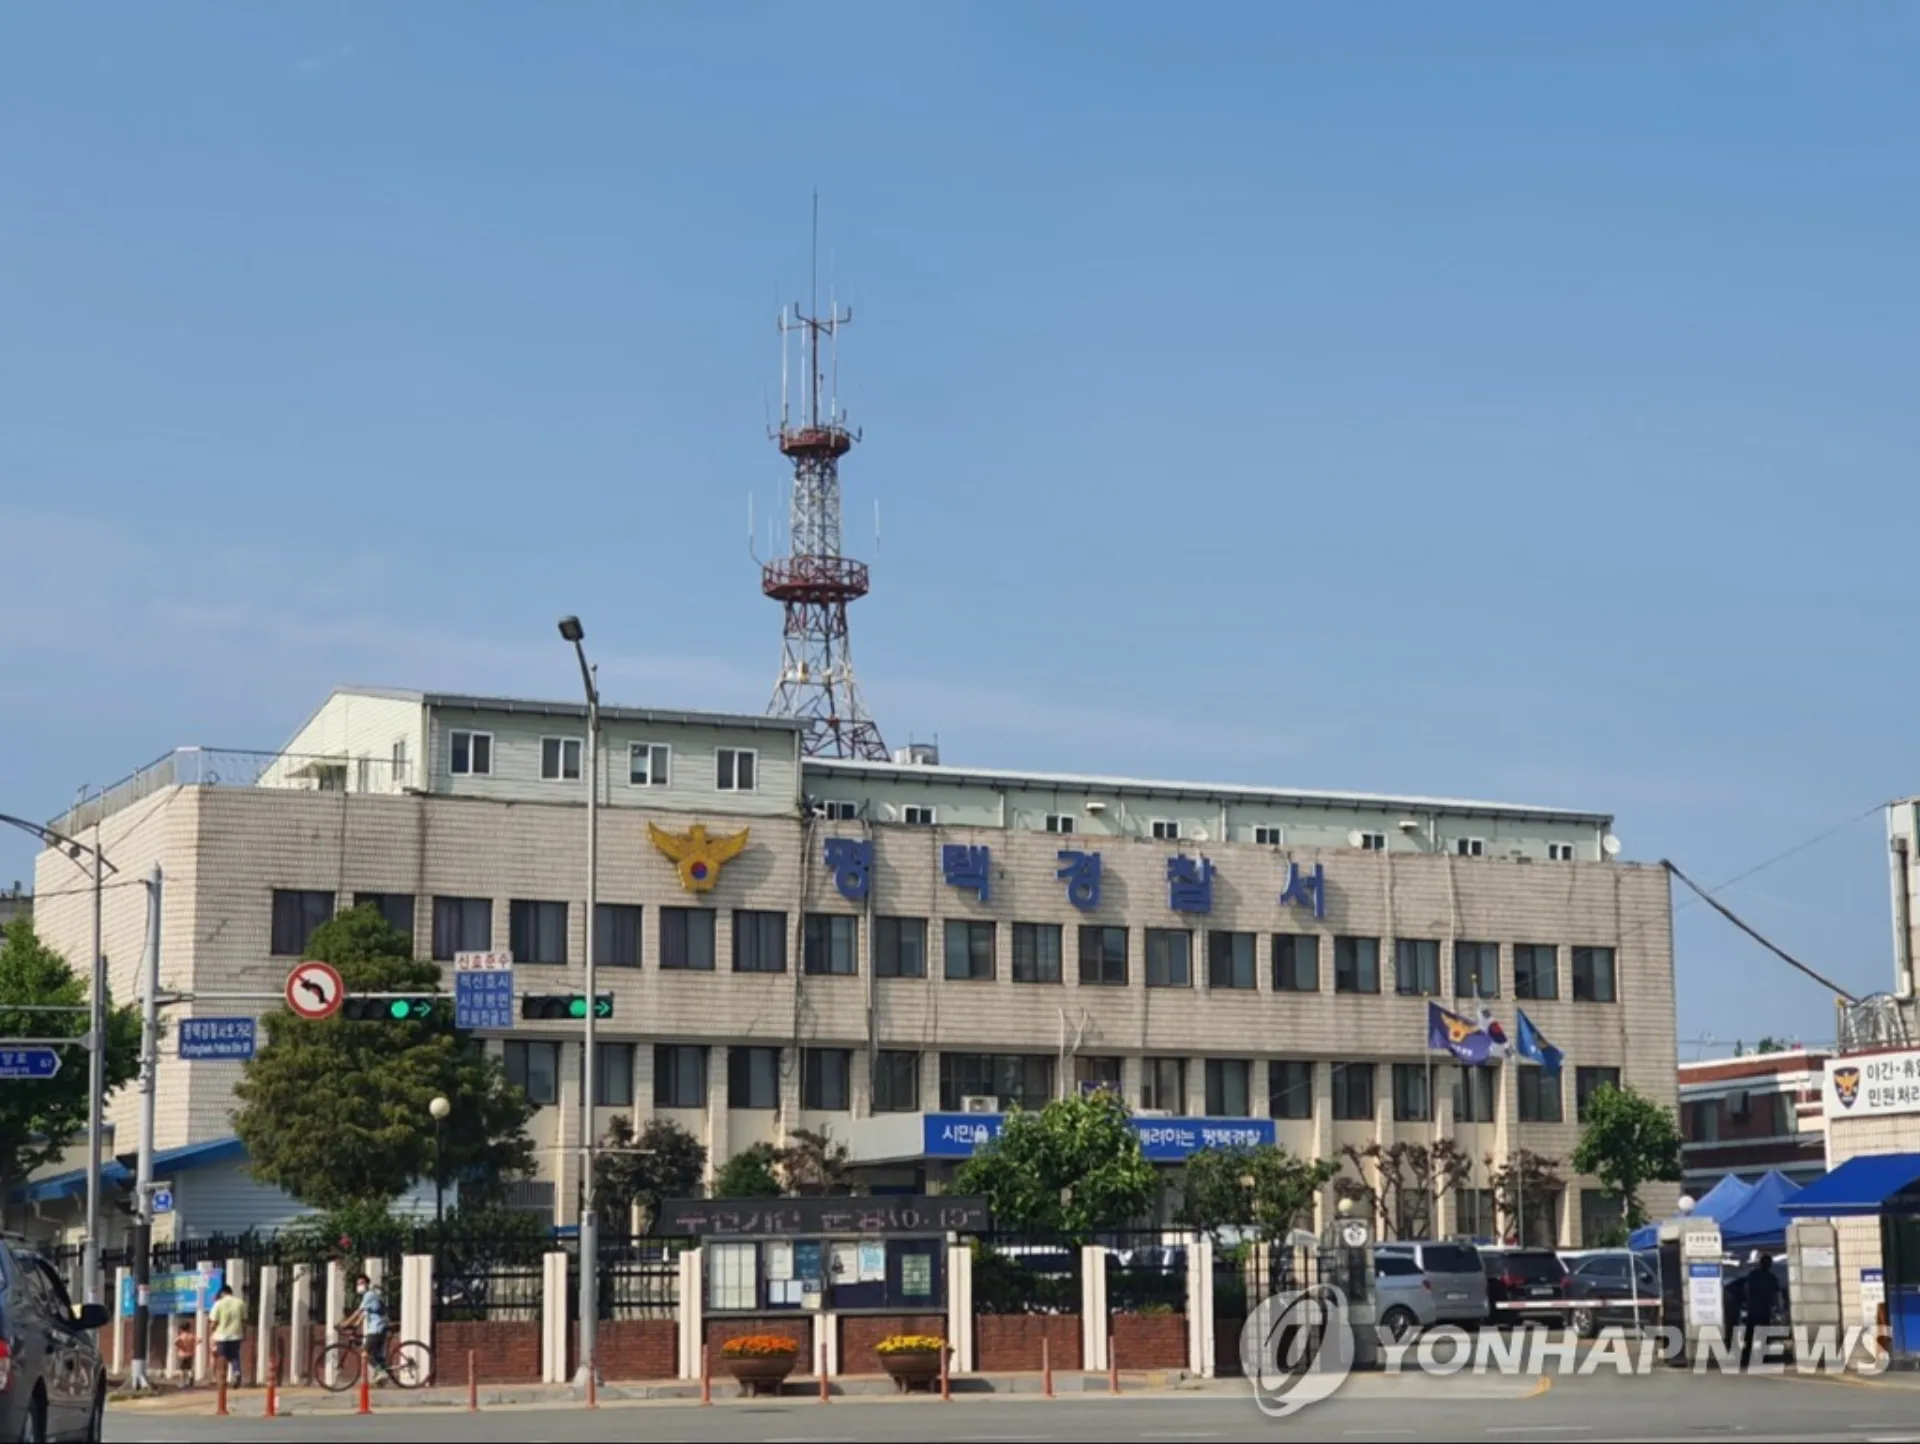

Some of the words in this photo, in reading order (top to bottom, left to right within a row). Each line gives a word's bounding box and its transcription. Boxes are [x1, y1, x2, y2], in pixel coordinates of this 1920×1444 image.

[824, 837, 1325, 918] 평택경찰서
[459, 953, 510, 970] 신호준수
[941, 1124, 989, 1144] 시민을
